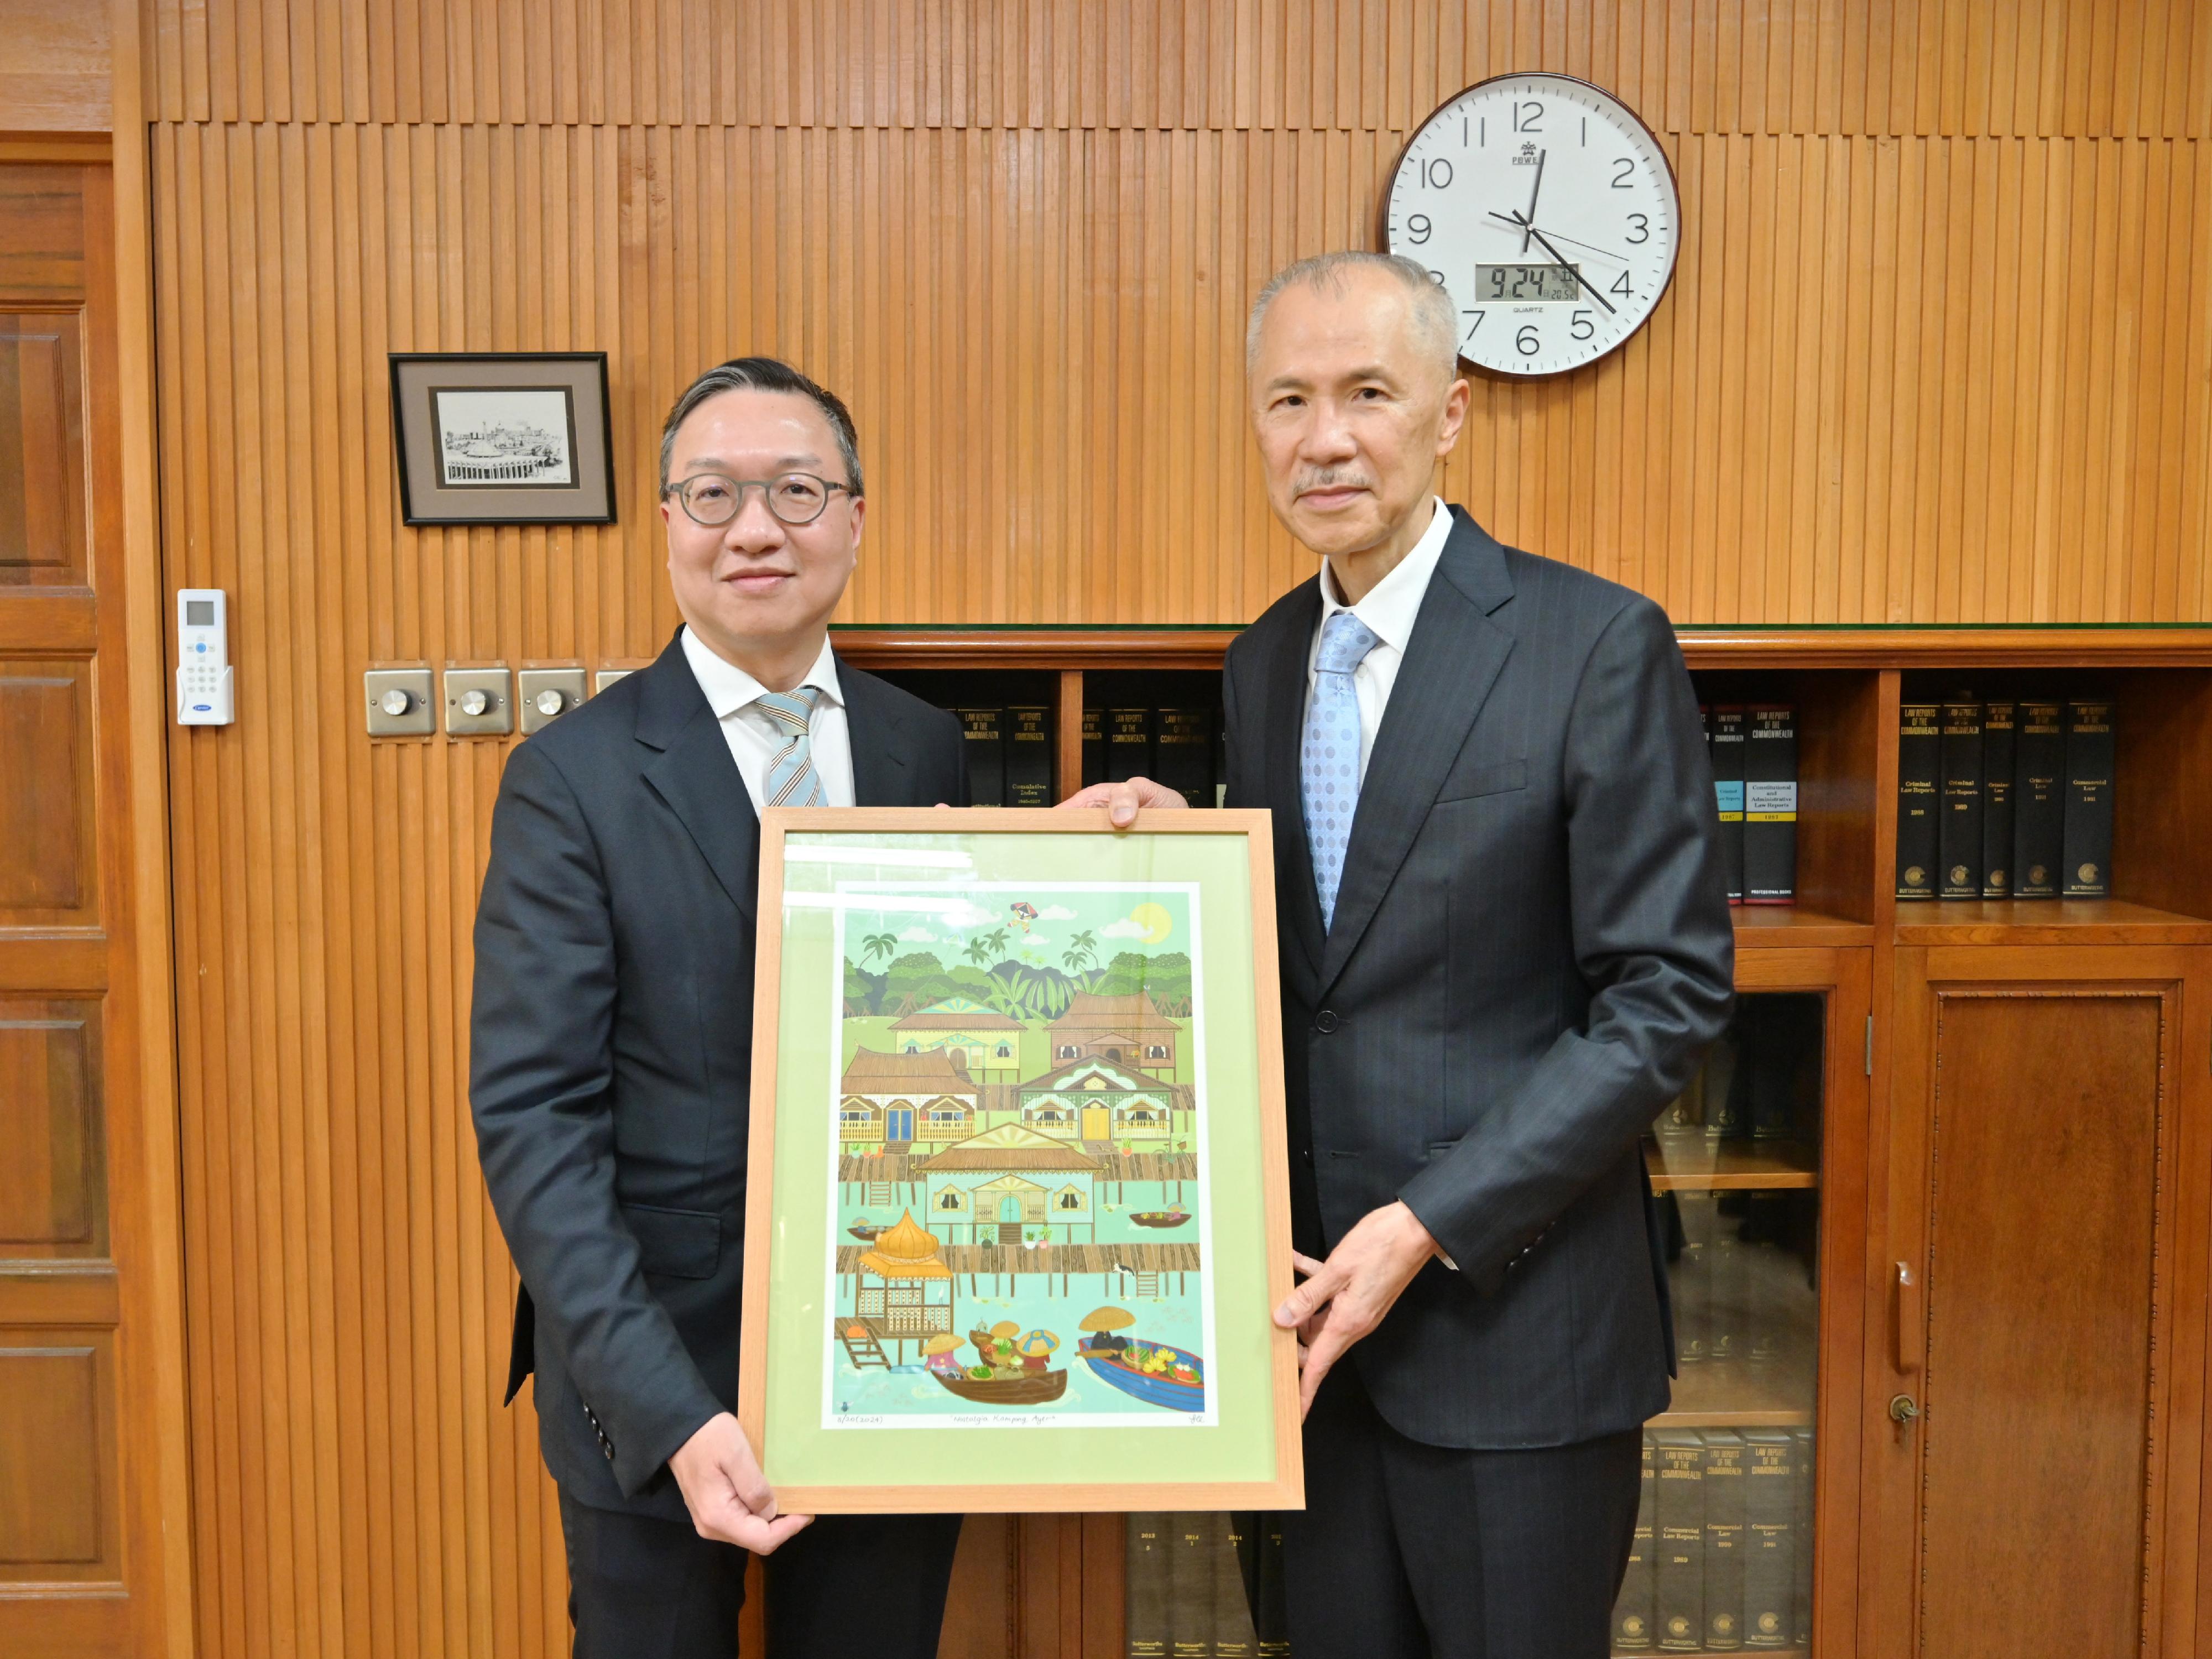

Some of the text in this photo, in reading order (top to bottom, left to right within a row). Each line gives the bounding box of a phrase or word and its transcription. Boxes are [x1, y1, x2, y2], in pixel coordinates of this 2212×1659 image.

[1513, 102, 1544, 133] 12
[1463, 117, 1485, 147] 11
[1581, 117, 1585, 147] 1
[1512, 156, 1543, 166] POWE
[1421, 158, 1453, 189] 10
[1611, 158, 1635, 189] 2
[1407, 213, 1432, 244] 9
[1624, 213, 1649, 244] 3
[1610, 270, 1635, 299] 4
[1462, 310, 1486, 341] 7
[1571, 310, 1595, 340] 5
[1515, 325, 1541, 356] 6
[966, 713, 995, 722] LAW REPORTS
[1757, 711, 1790, 721] LAW REPORTS
[1905, 708, 1936, 717] LAW REPORTS
[1165, 714, 1176, 723] LAW
[1912, 718, 1927, 726] OF THE
[973, 722, 978, 731] OF
[1765, 721, 1780, 729] OF THE
[1944, 726, 1979, 734] COMMONWEALTH
[2025, 725, 2059, 733] COMMONWEALTH
[1015, 732, 1044, 740] COMMONWEALTH
[1752, 729, 1793, 739] COMMONWEALTH
[1901, 727, 1939, 735] COMMONWEALTH
[1112, 734, 1146, 743] COMMONWEALTH
[993, 1415, 1026, 1425] Kampong
[1666, 1451, 1698, 1462] LAW REPORTS
[1756, 1448, 1766, 1456] LAW
[1674, 1460, 1689, 1469] OF THE
[1763, 1457, 1769, 1465] OF
[1662, 1470, 1702, 1480] COMMONWEALTH
[1707, 1467, 1742, 1475] COMMONWEALTH
[1751, 1466, 1790, 1475] COMMONWEALTH
